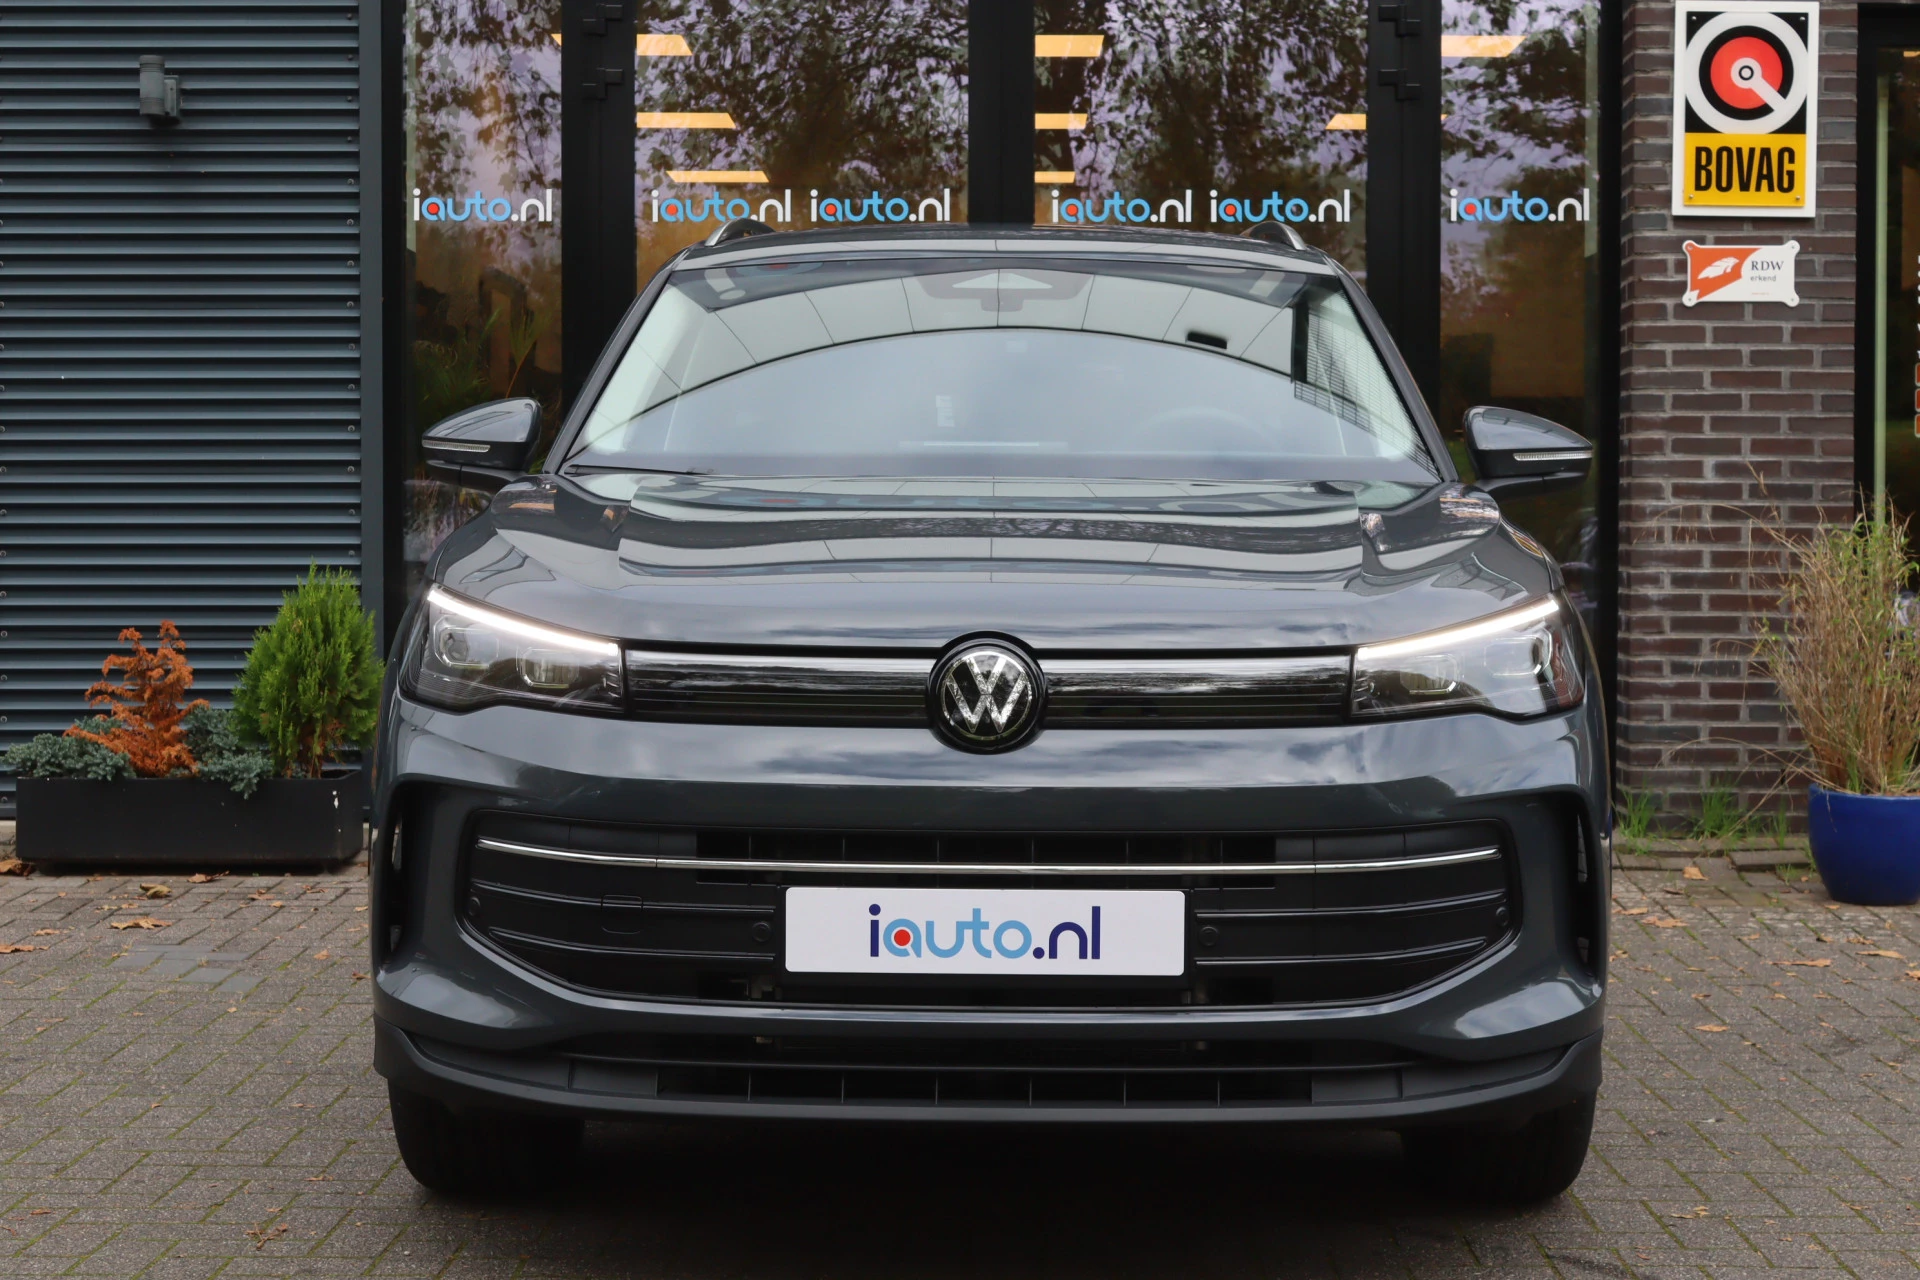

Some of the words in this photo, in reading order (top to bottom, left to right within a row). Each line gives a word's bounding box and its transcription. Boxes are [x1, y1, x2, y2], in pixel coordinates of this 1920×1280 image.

[1694, 145, 1795, 193] BOVAG
[412, 188, 553, 222] iauto.nl
[651, 189, 792, 222] iauto.nl
[810, 189, 951, 222] iauto.nl
[1051, 189, 1192, 223] iauto.nl
[1209, 189, 1351, 223] iauto.nl
[1450, 188, 1590, 222] iauto.nl
[1751, 260, 1784, 271] RDW
[868, 903, 1101, 960] iauto.nl
